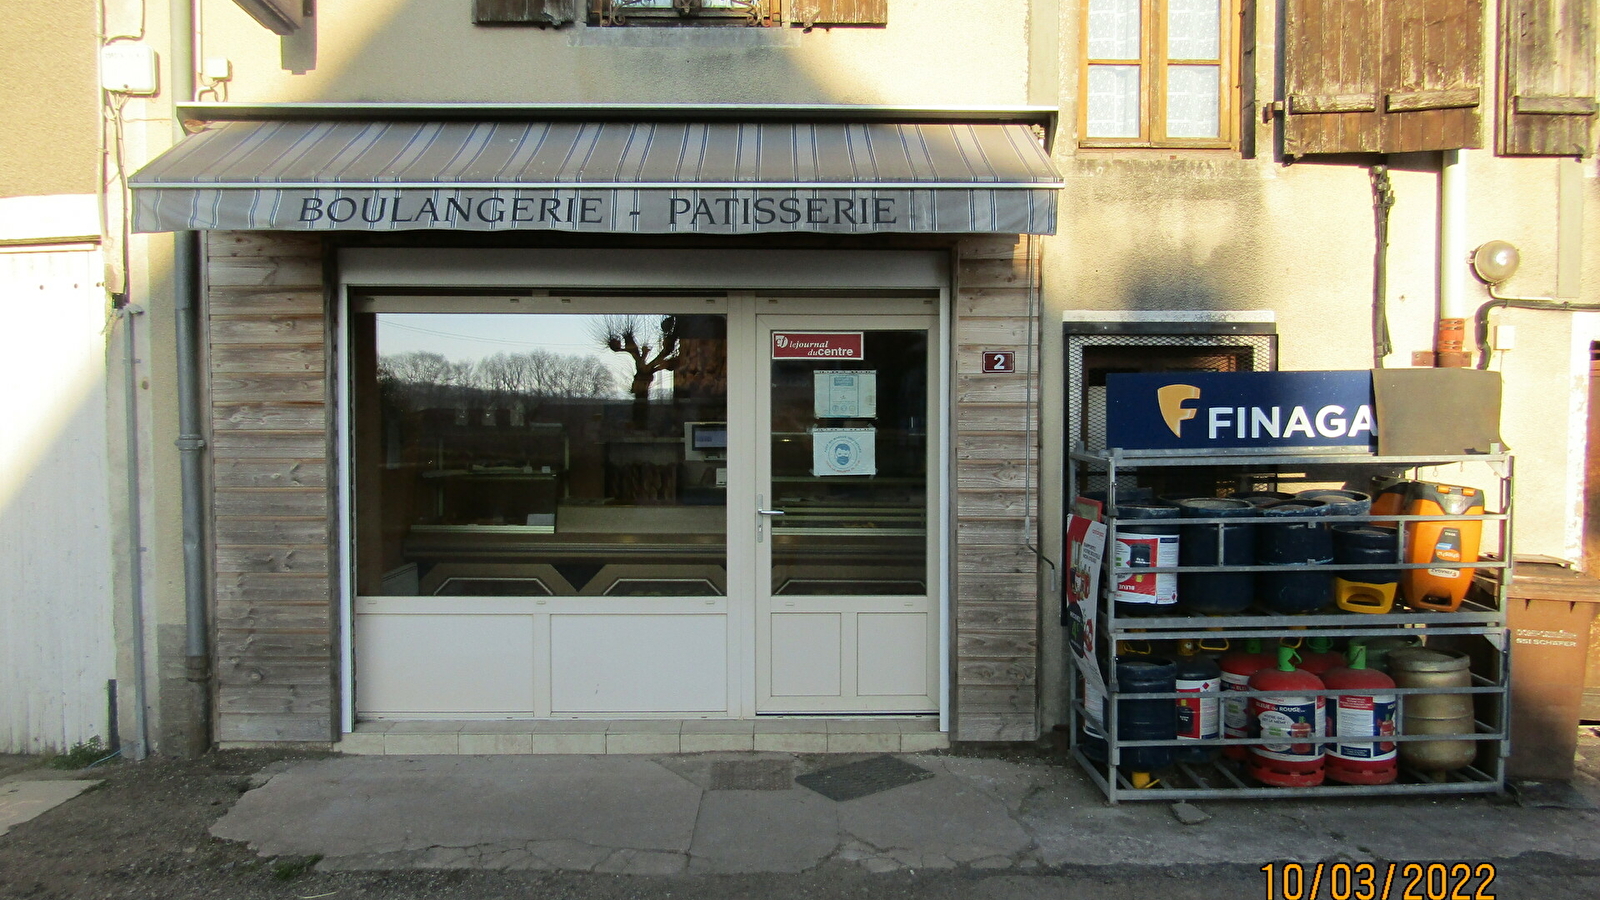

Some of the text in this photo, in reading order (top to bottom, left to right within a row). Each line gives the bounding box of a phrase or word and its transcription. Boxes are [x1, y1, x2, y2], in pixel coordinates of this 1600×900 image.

[298, 197, 603, 223] BOULANGERIE
[668, 198, 897, 224] PATISSERIE
[993, 354, 1005, 370] 2
